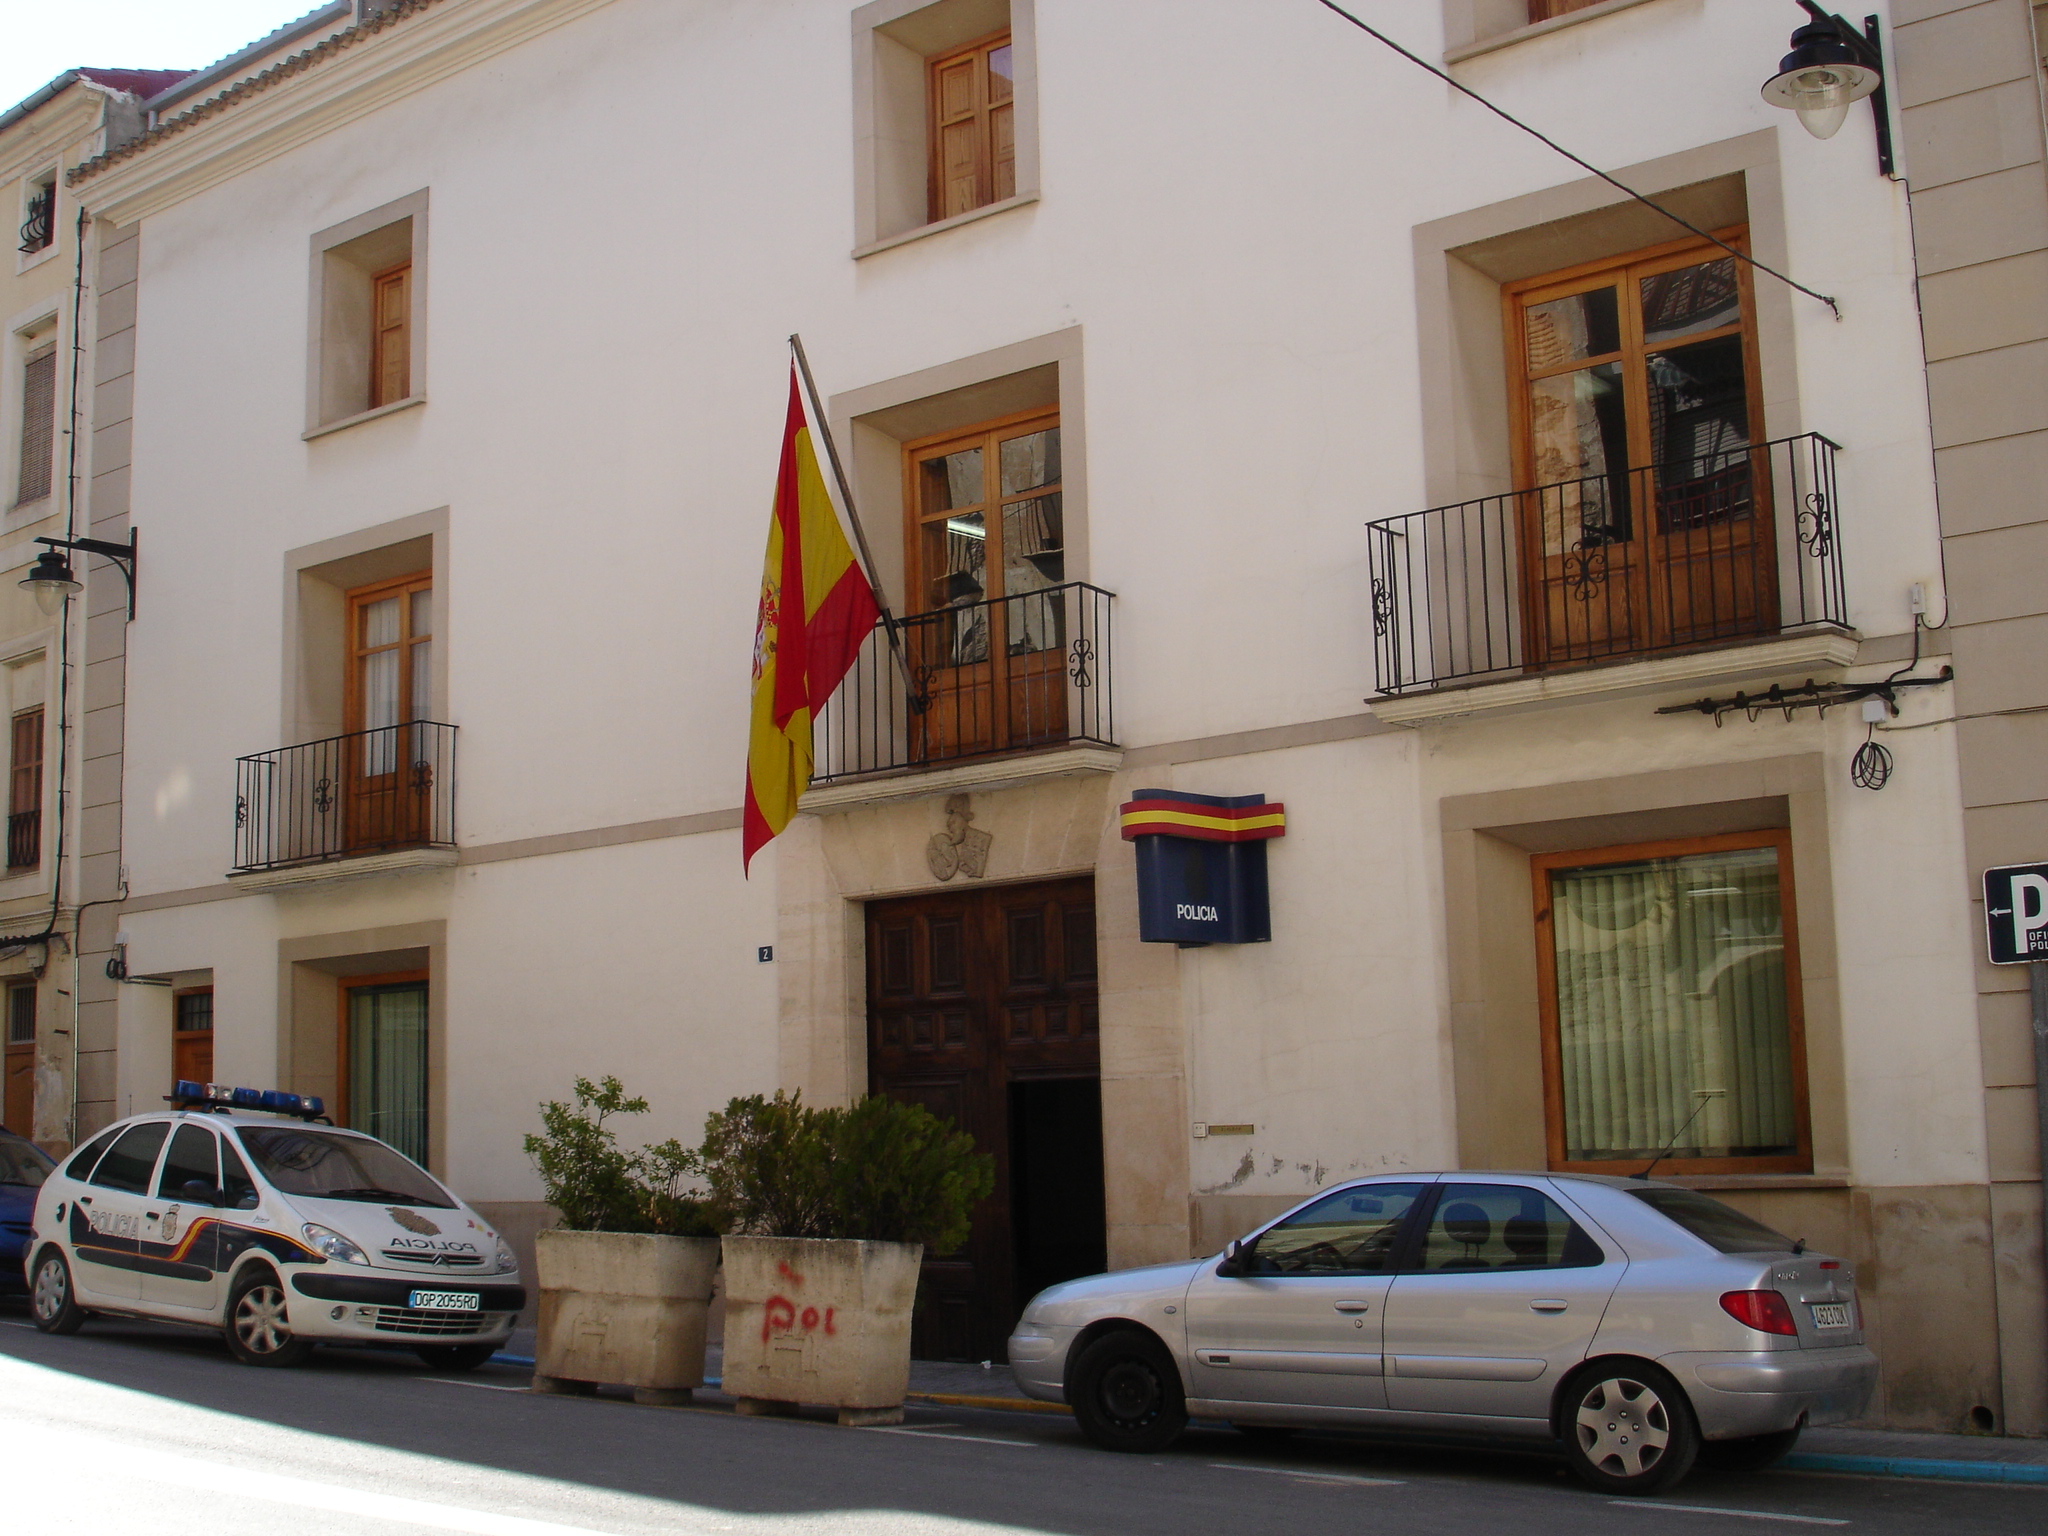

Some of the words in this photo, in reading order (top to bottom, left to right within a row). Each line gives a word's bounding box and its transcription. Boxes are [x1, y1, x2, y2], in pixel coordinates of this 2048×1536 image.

[1176, 903, 1219, 922] POLICIA
[2010, 873, 2048, 954] P
[2028, 930, 2048, 941] OFI
[763, 948, 769, 960] 2
[88, 1210, 140, 1240] POLICIA
